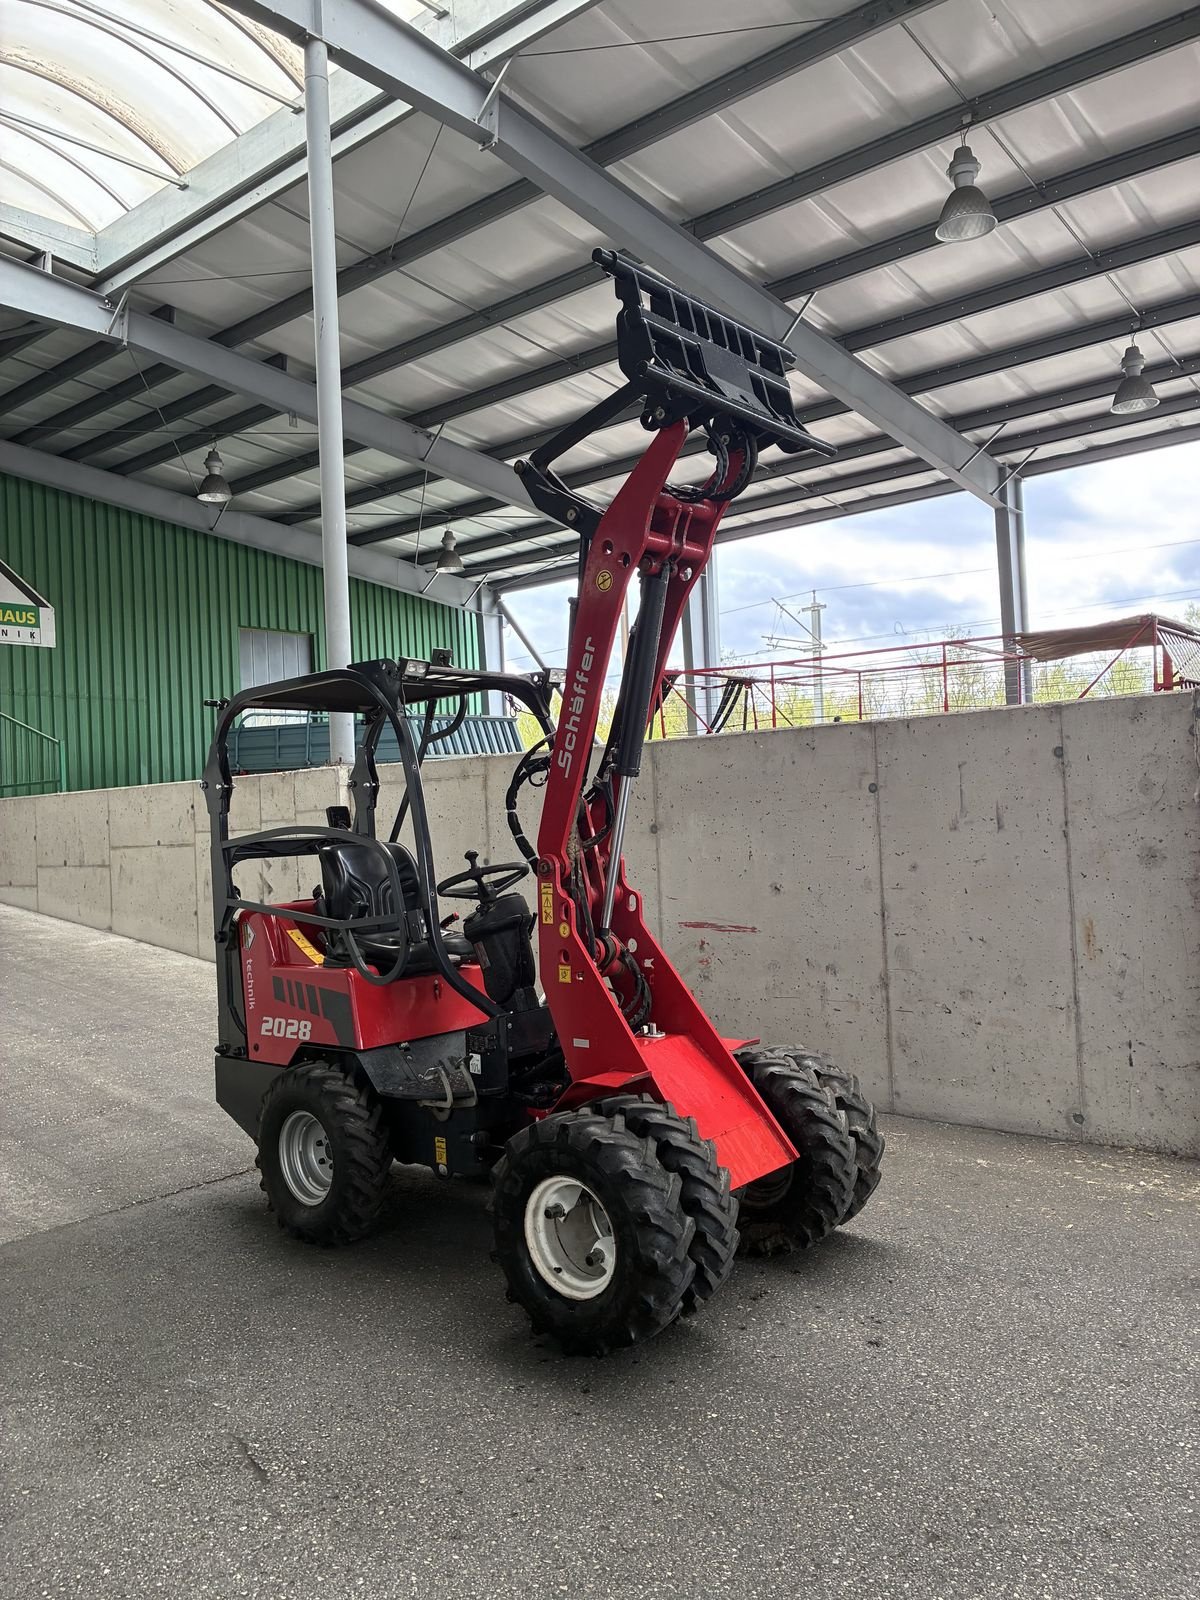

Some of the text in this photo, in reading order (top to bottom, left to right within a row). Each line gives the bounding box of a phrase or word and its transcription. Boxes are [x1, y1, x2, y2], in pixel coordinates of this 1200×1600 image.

[0, 609, 35, 624] AUS
[558, 636, 596, 779] Schäffer
[246, 958, 256, 1010] technik
[260, 1016, 312, 1041] 2028
